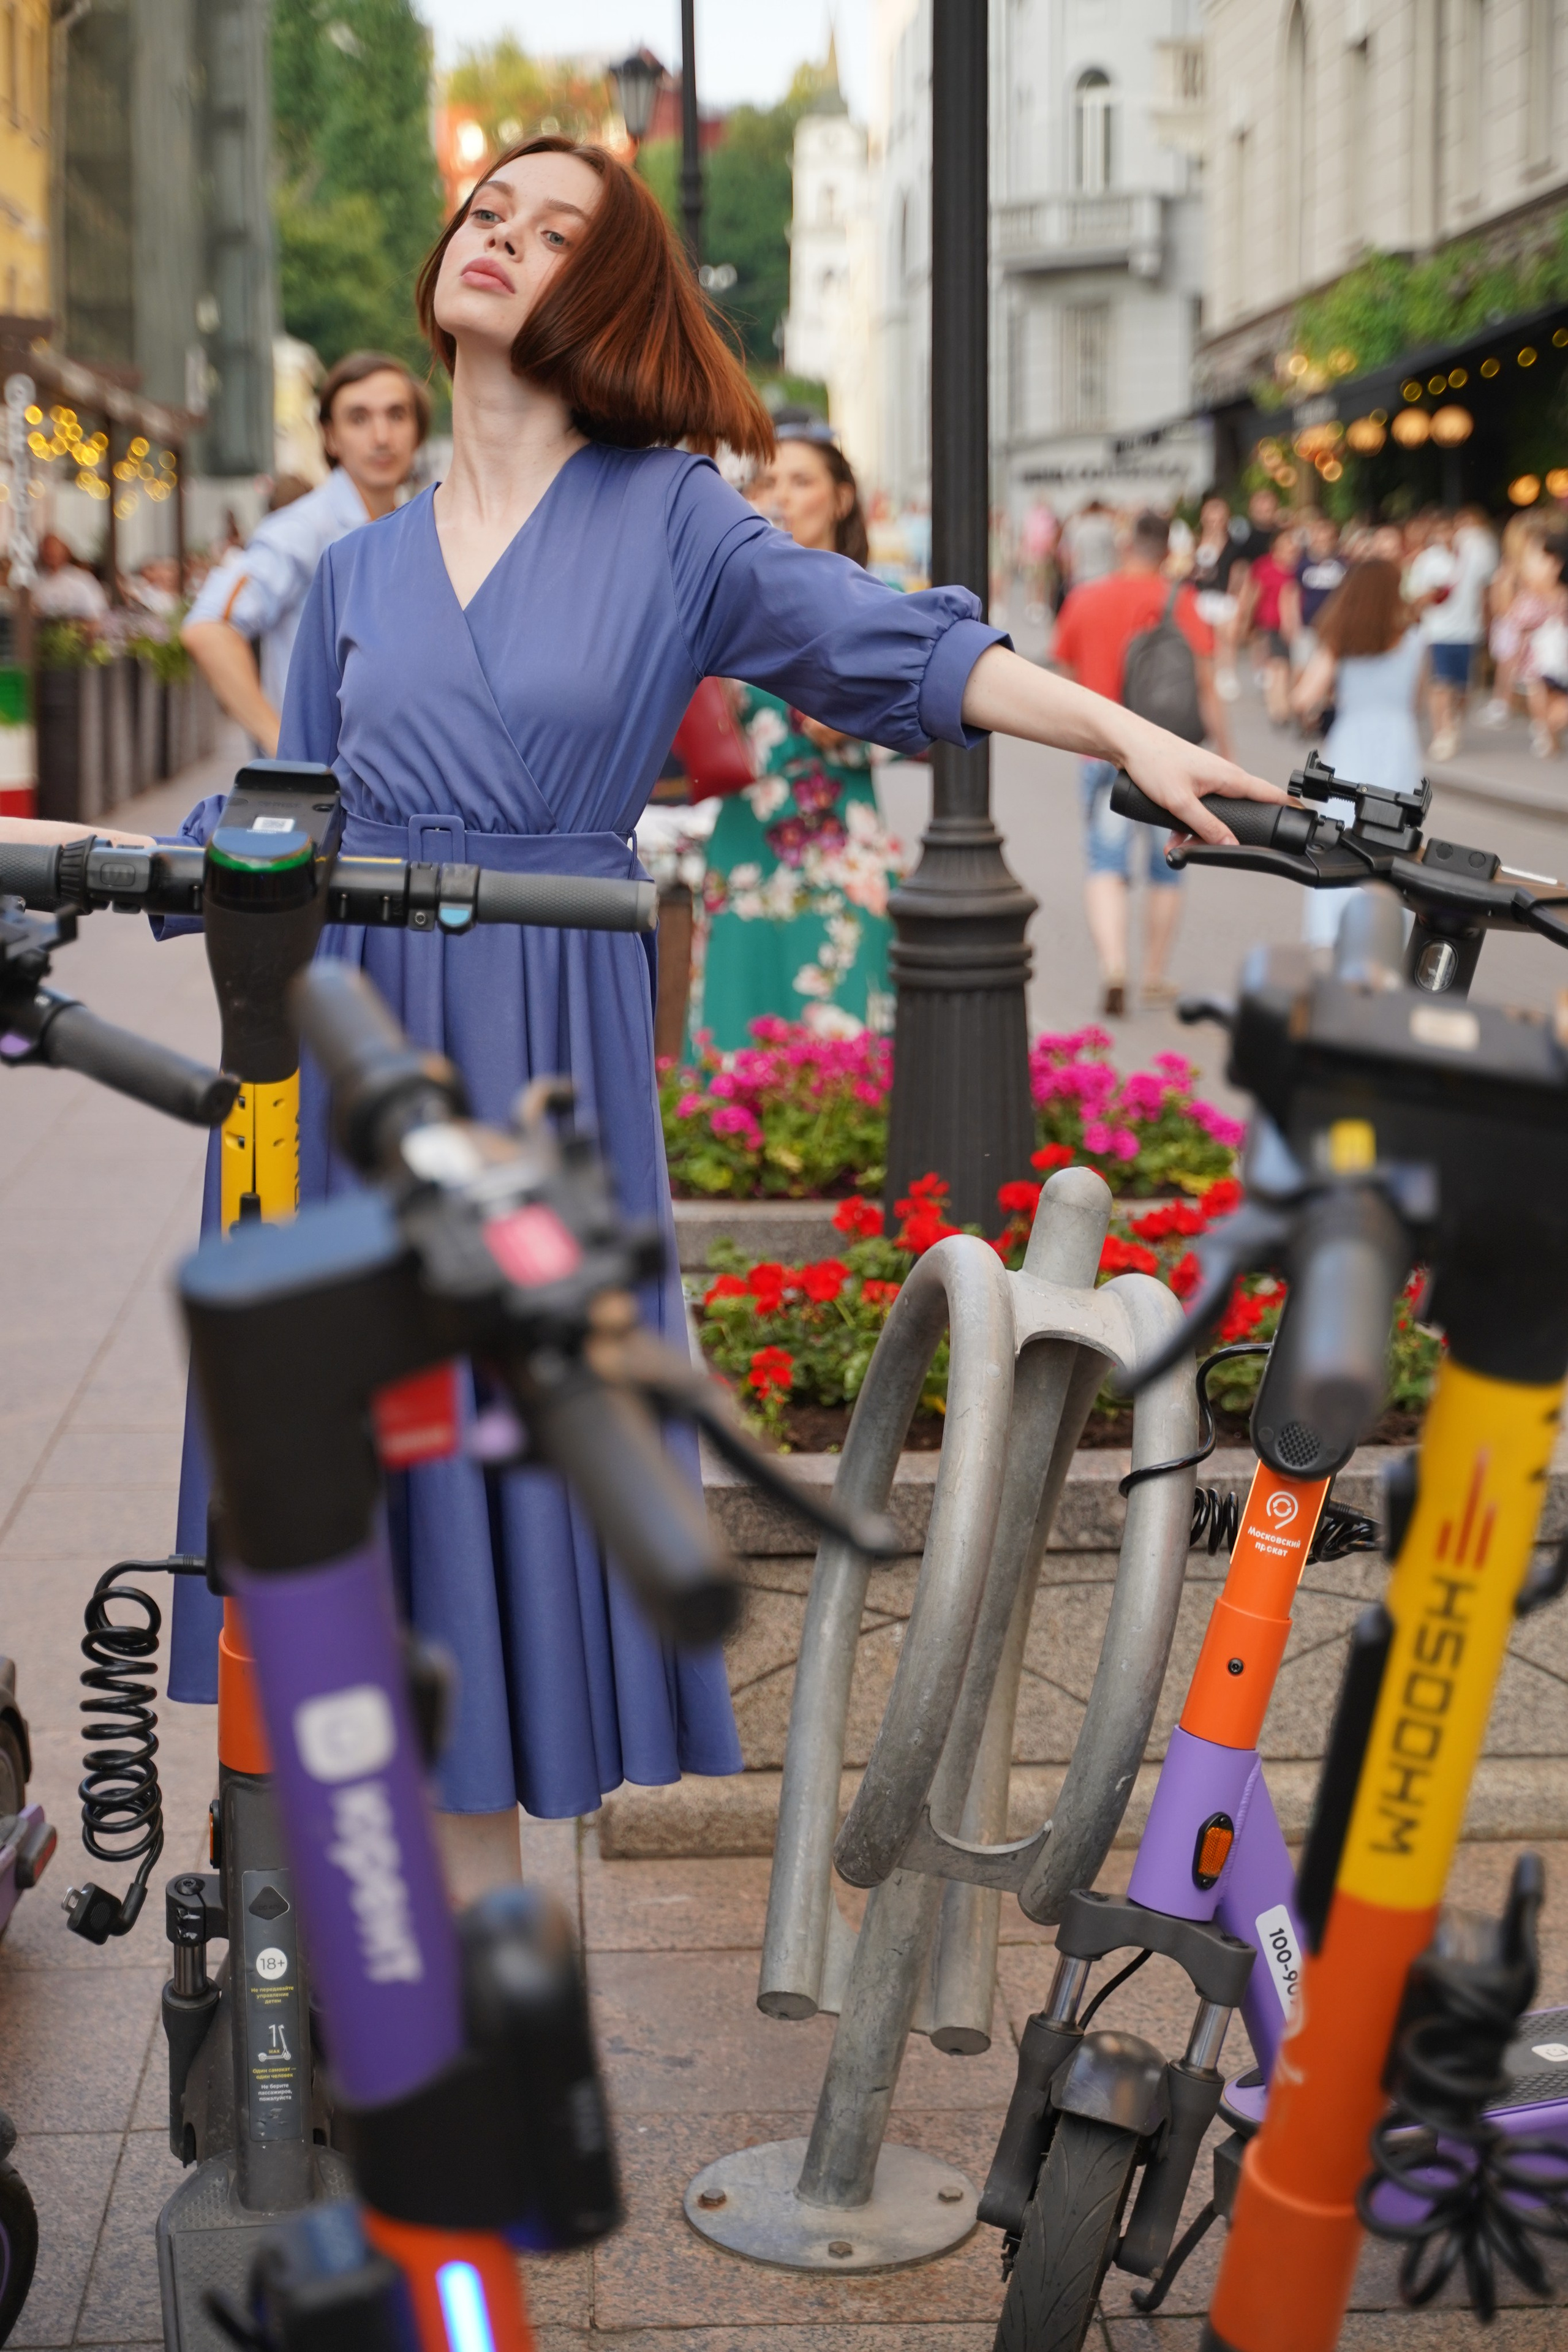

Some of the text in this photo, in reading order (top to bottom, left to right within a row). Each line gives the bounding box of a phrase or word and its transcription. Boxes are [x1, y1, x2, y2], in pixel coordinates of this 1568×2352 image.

[1247, 1525, 1301, 1548] Московский
[1254, 1541, 1288, 1557] прокат
[1367, 1572, 1476, 1856] WHOOSH
[260, 1958, 285, 1970] 18+
[1268, 1928, 1298, 2005] 100-90
